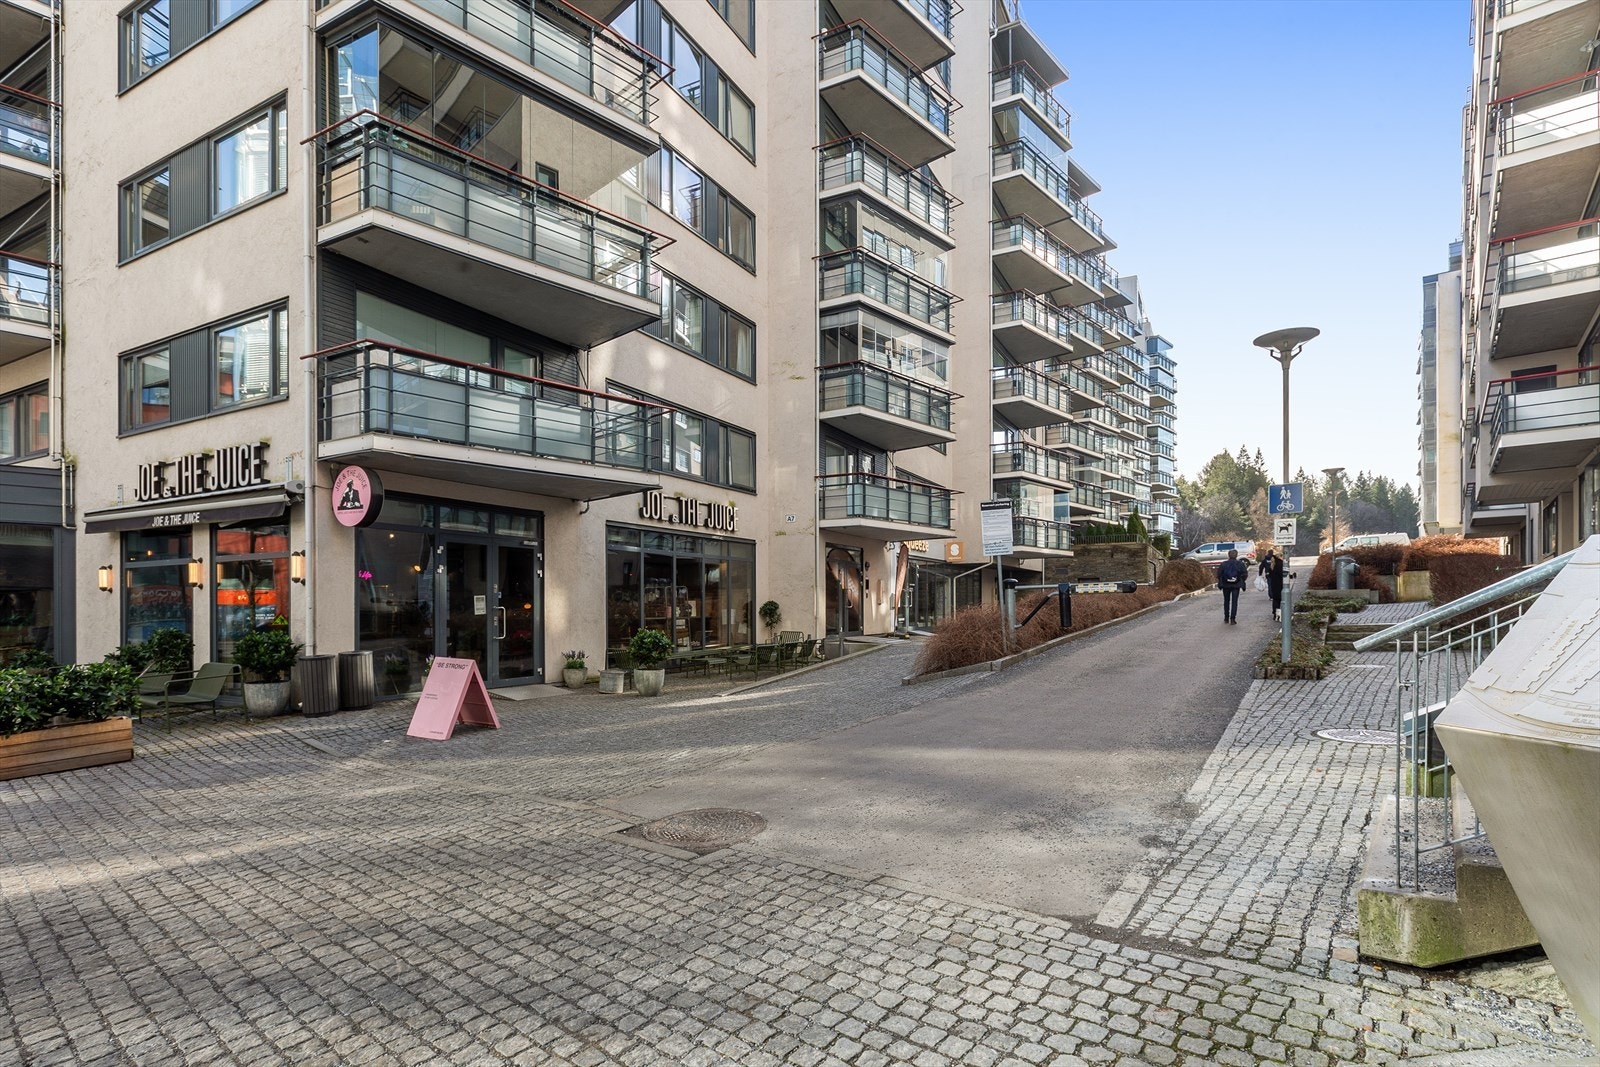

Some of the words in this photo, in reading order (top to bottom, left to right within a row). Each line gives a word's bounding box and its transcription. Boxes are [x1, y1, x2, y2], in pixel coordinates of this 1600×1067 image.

[134, 461, 160, 501] JOE
[163, 486, 172, 498] &
[172, 452, 203, 496] THE
[210, 441, 261, 491] JUICE
[356, 473, 368, 490] JUICE
[643, 490, 669, 521] JOE
[672, 514, 680, 523] &
[679, 496, 704, 526] THE
[708, 502, 739, 531] JUICE
[152, 515, 163, 527] JOE
[163, 515, 170, 526] &
[170, 514, 182, 526] THE
[182, 512, 200, 525] JUICE
[903, 540, 930, 552] queeze
